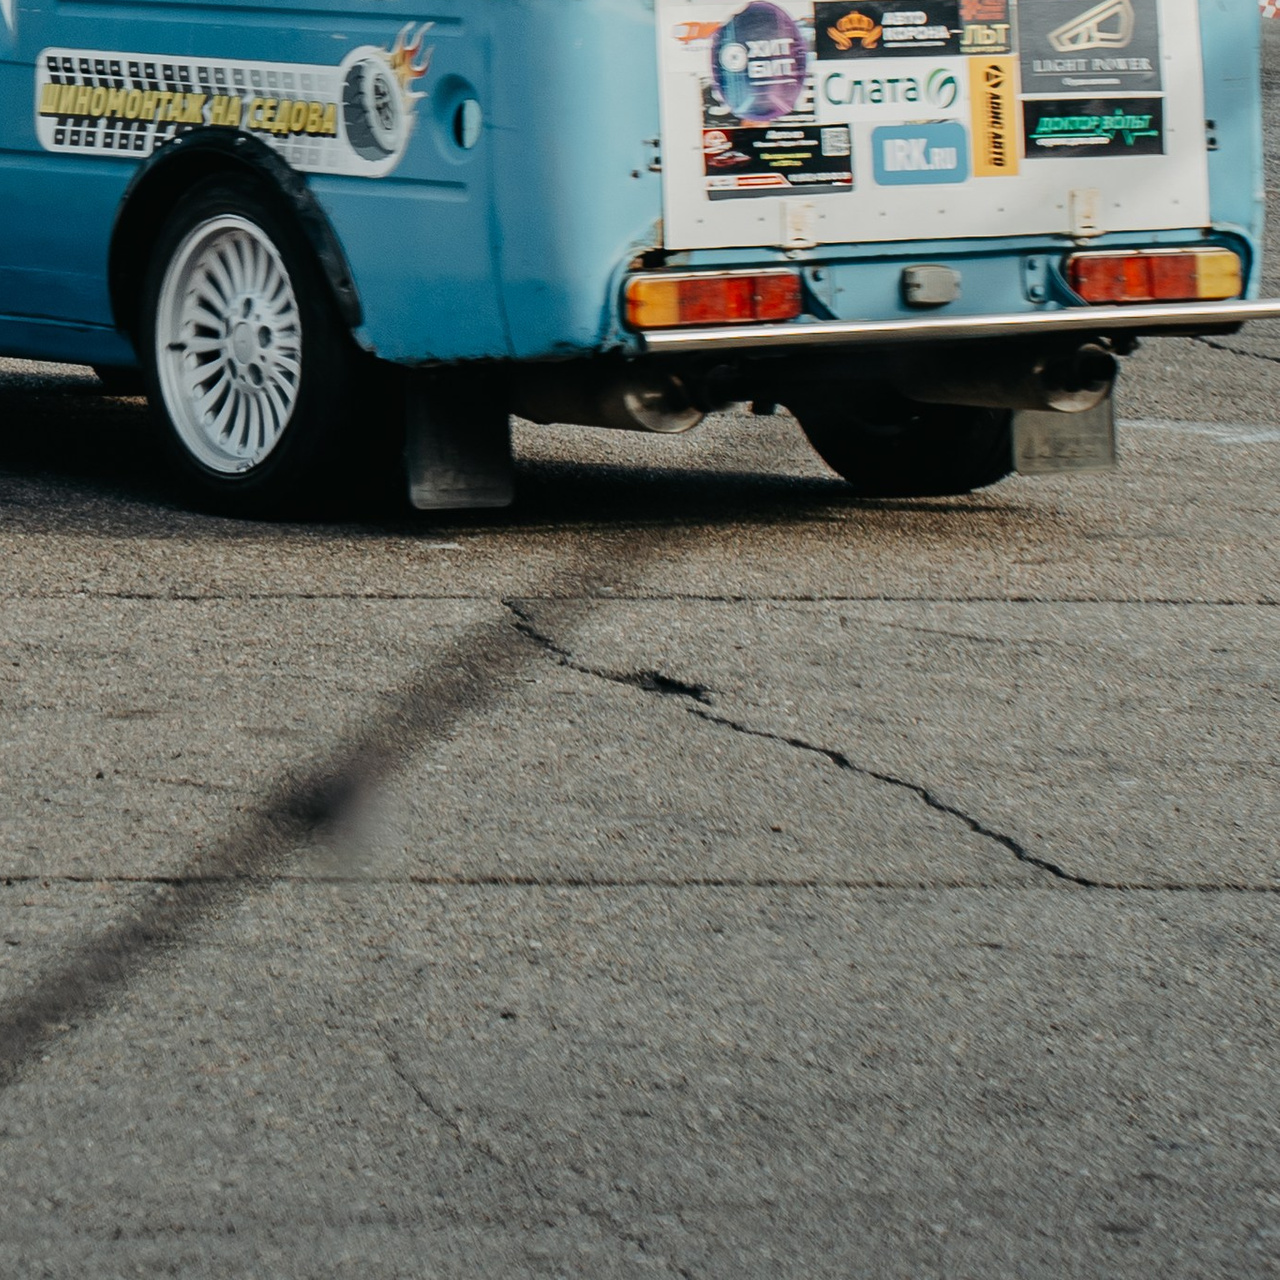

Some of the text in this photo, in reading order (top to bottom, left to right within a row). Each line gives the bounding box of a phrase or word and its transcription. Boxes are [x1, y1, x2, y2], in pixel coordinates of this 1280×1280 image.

[882, 25, 951, 41] КОРОНА
[1032, 58, 1153, 72] LIGHT POWER
[825, 72, 919, 105] Слата
[38, 82, 338, 137] ШИНОМОНТАЖ НА СЕДОВА
[1035, 114, 1154, 133] ДОКТОР ВОЛЬТ
[883, 137, 958, 172] IRK.RU
